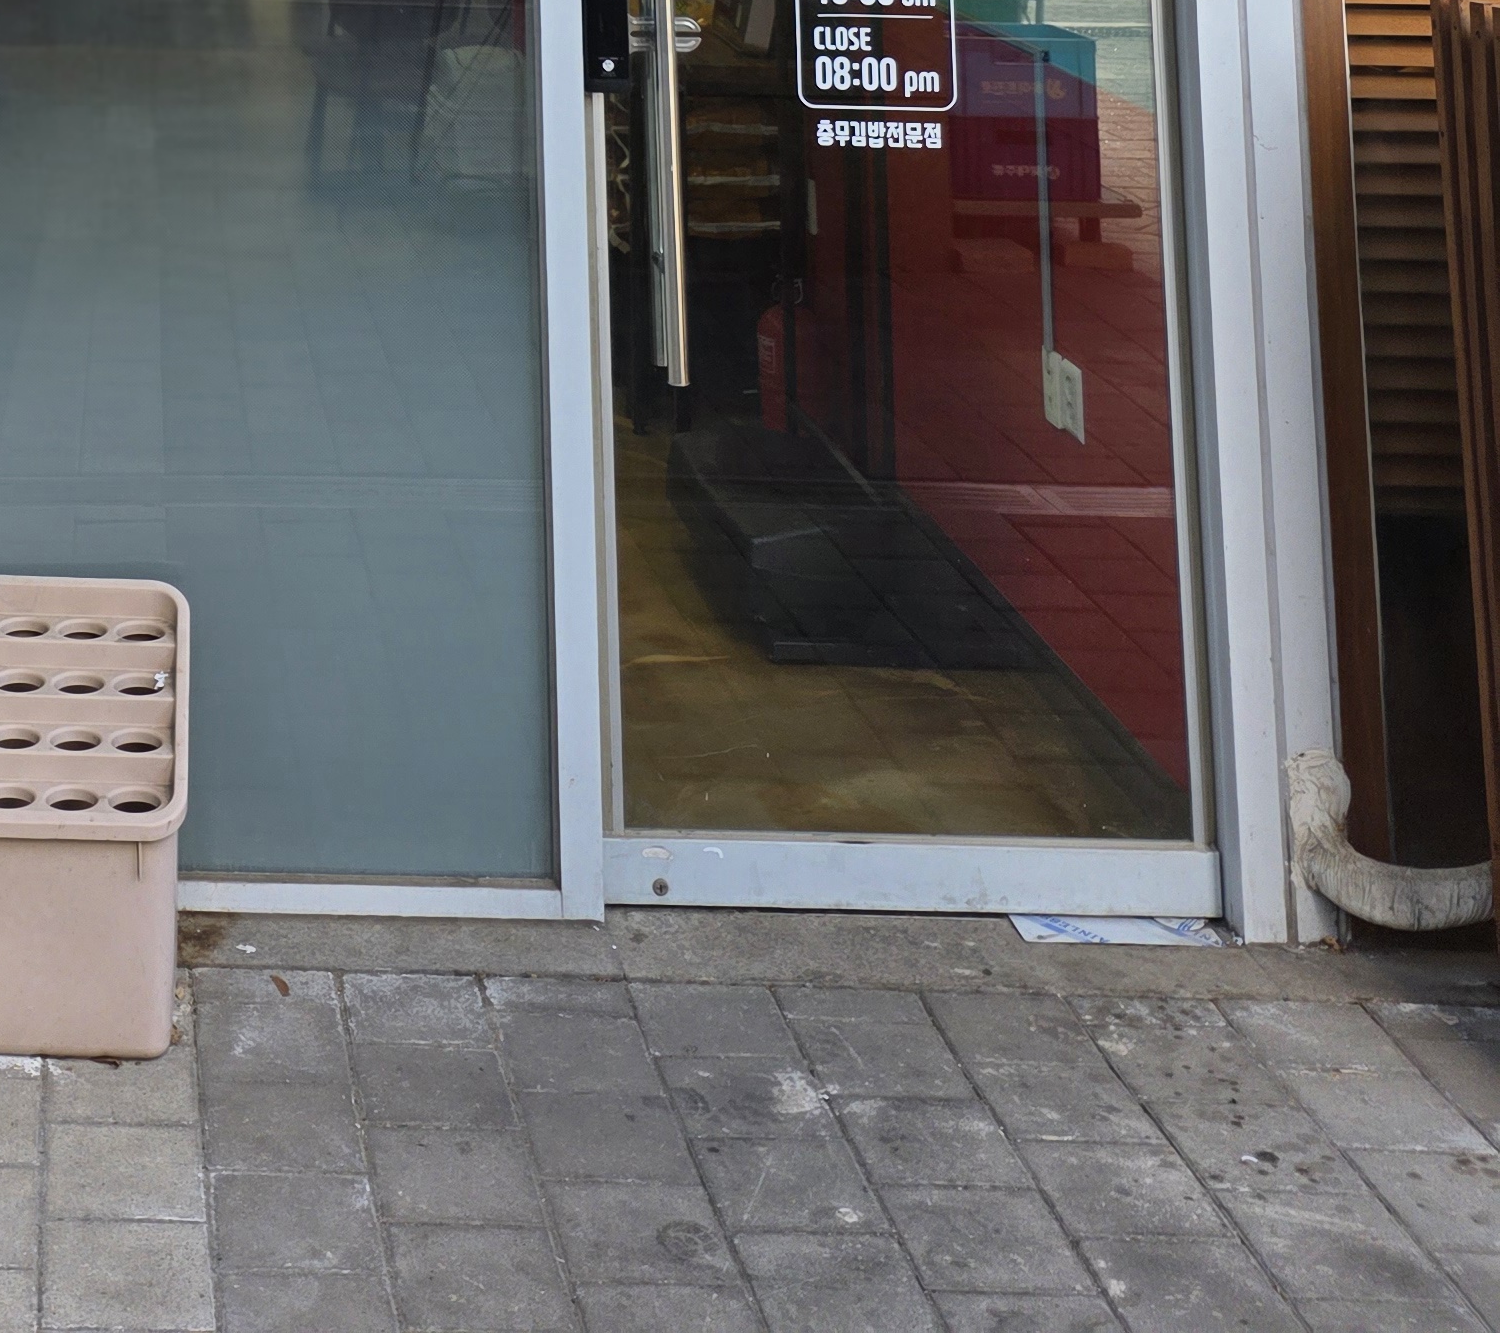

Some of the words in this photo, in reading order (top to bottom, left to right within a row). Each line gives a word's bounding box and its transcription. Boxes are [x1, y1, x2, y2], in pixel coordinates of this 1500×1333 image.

[813, 25, 873, 51] CLOSE
[815, 55, 898, 92] 08:00
[904, 70, 941, 98] pm
[816, 119, 942, 149] 충무김밥전문점
